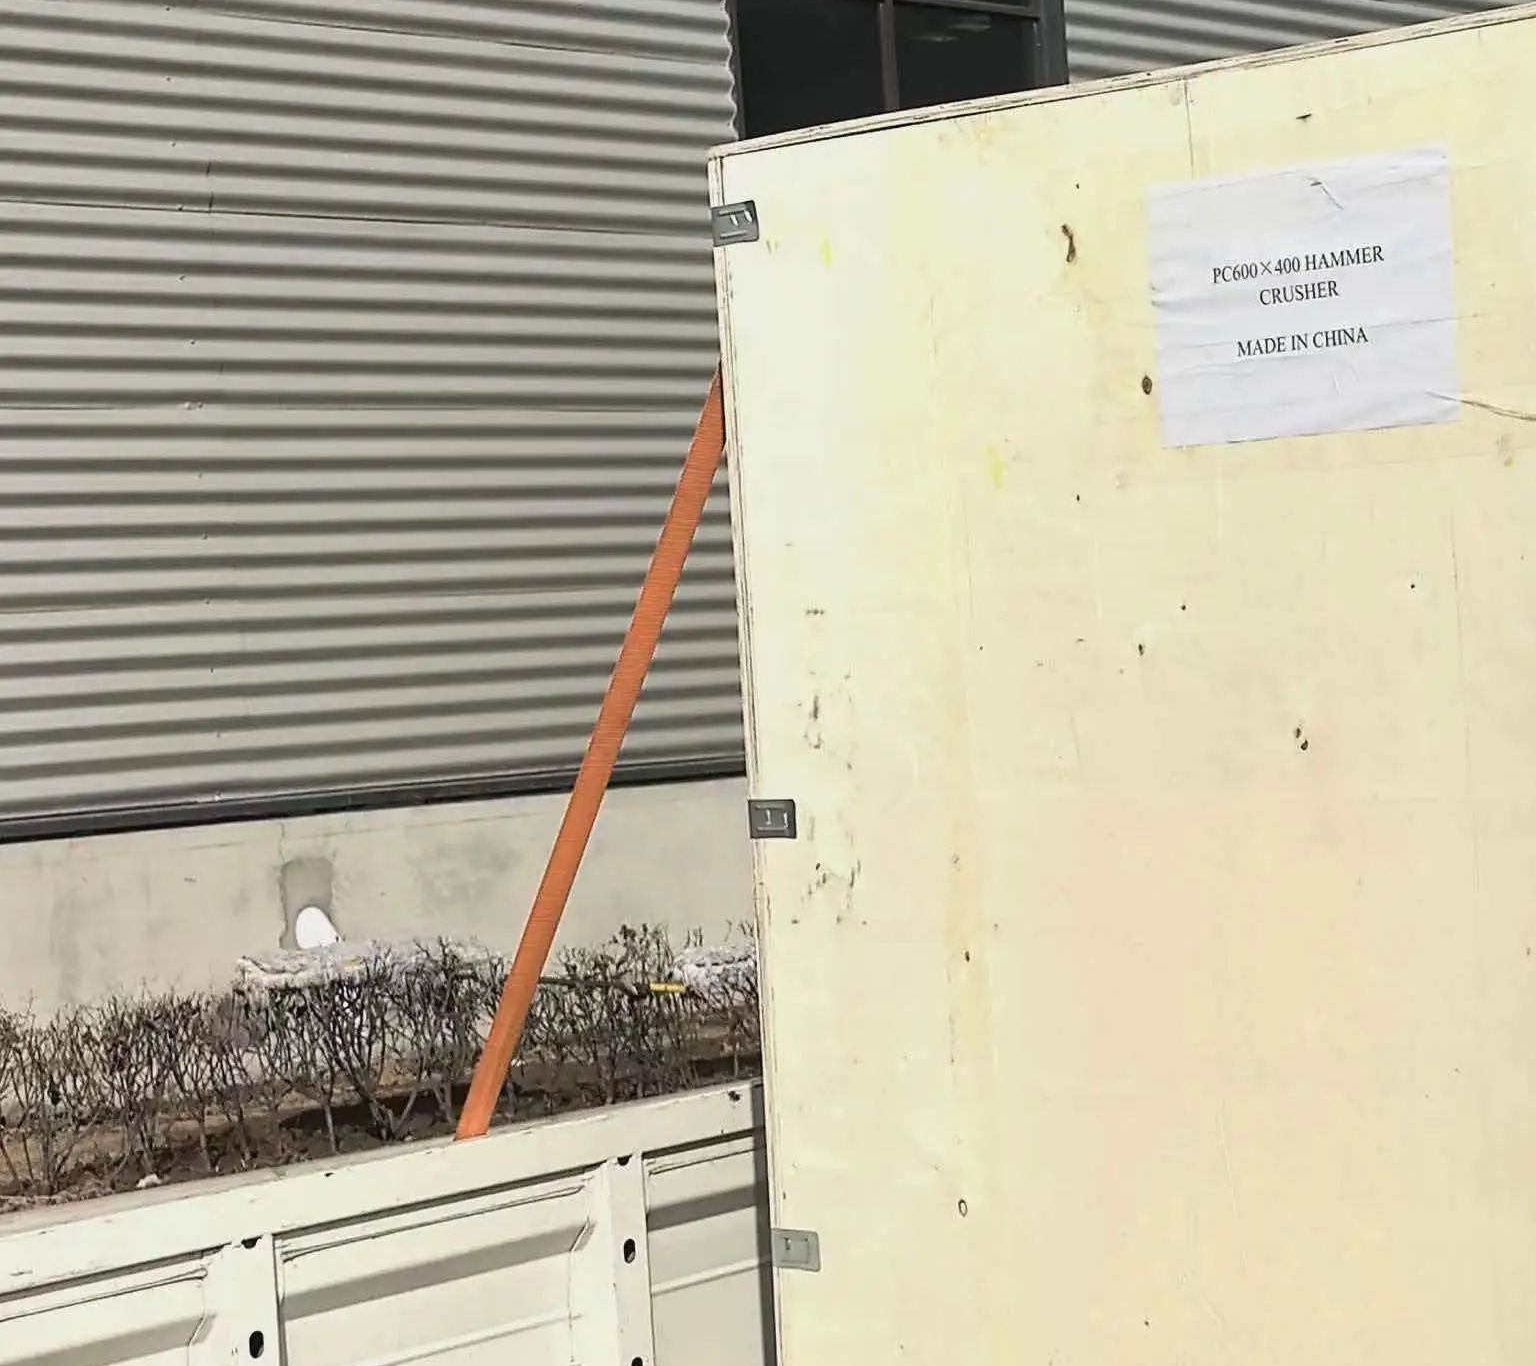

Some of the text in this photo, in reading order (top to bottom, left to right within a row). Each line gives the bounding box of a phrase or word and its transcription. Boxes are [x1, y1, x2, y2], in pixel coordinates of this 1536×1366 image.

[1304, 245, 1384, 271] HAMMER
[1258, 280, 1339, 306] CRUSHER
[1236, 327, 1369, 357] MADE IN CHINA
